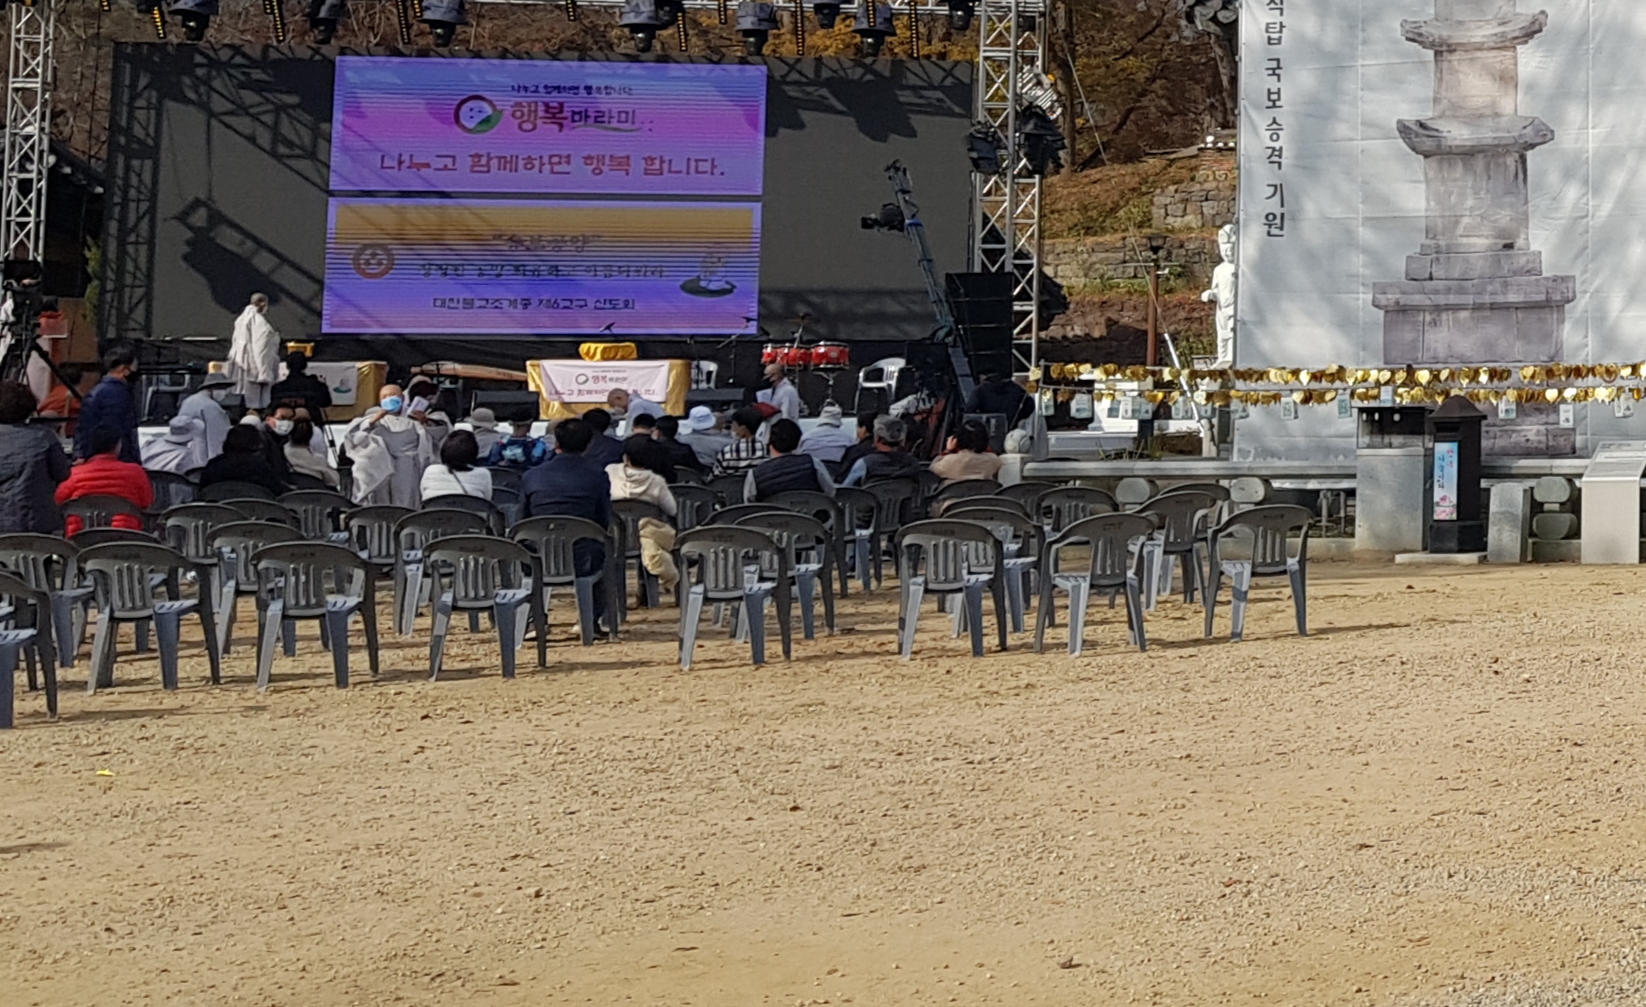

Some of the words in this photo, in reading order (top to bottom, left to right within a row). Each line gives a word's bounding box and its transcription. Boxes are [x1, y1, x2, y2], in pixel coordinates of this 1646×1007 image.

[1264, 57, 1285, 171] 국보승격
[380, 152, 458, 173] 나누고
[468, 152, 572, 175] 함께하면
[582, 153, 633, 176] 행복
[642, 154, 726, 177] 합니다.
[1262, 182, 1286, 238] 기원
[432, 297, 531, 310] 대한불교조계종
[537, 297, 589, 310] 제6교구
[593, 297, 636, 310] 신도회
